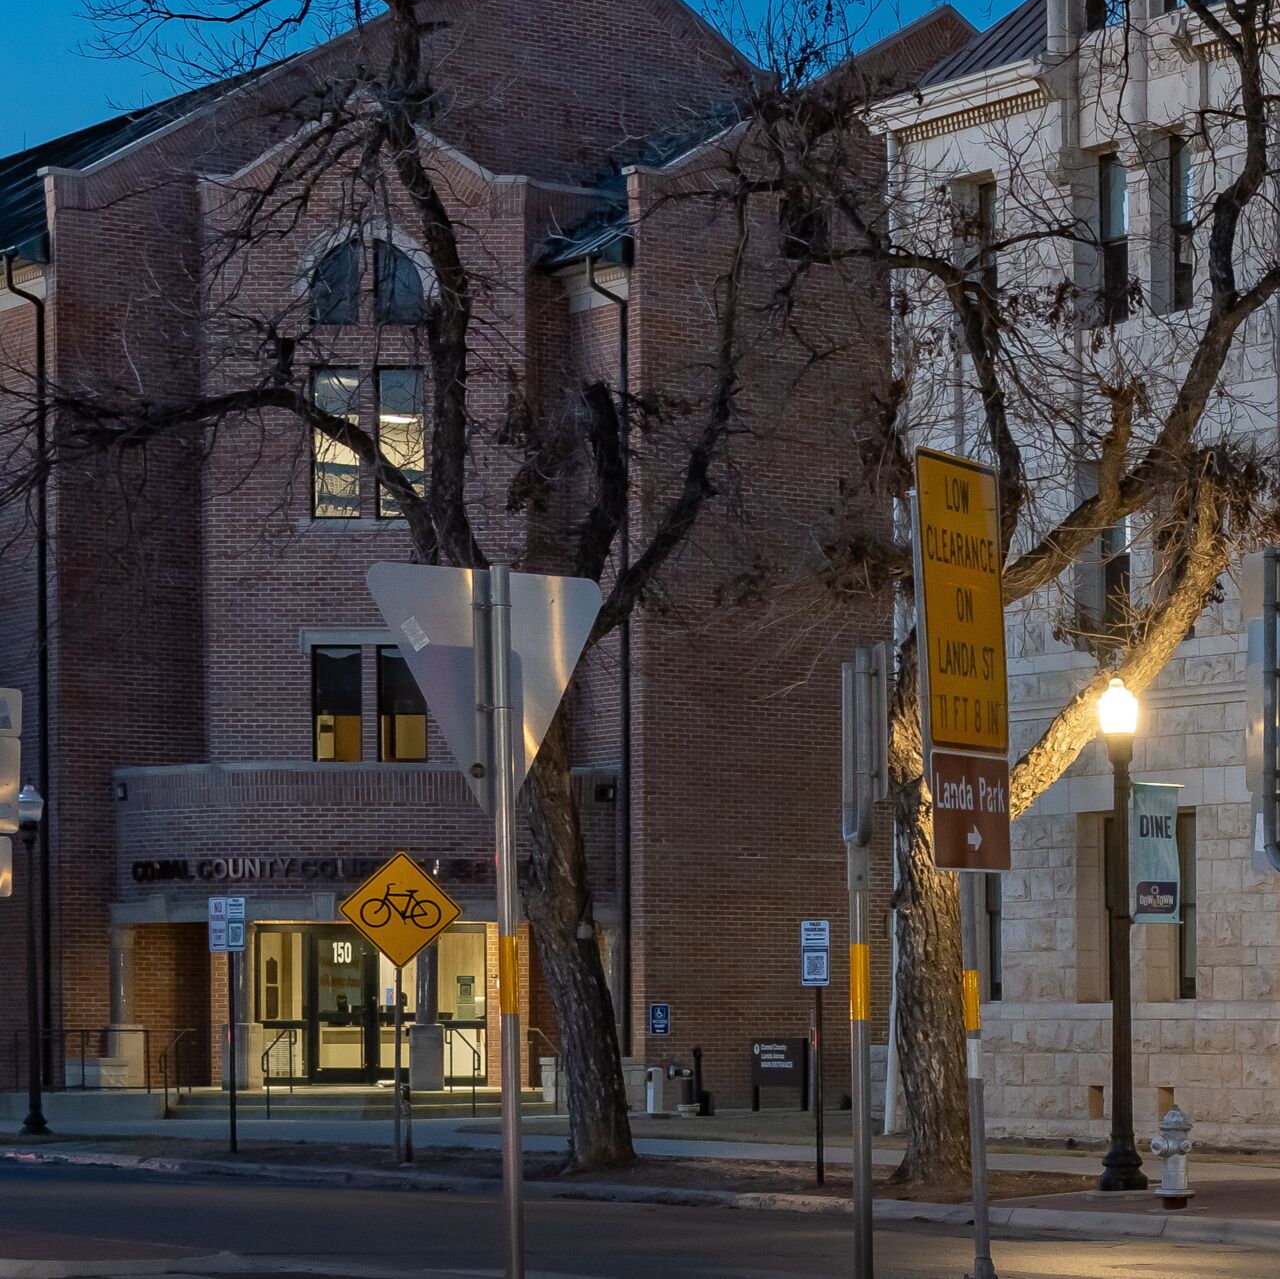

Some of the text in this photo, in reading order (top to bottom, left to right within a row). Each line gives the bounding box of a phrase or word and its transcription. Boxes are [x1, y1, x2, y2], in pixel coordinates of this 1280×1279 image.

[944, 474, 970, 515] LOW
[925, 524, 996, 574] CLEARANCE
[955, 586, 974, 625] ON
[937, 637, 995, 681] LANDA ST
[953, 695, 969, 732] FT
[974, 698, 982, 734] 8
[987, 700, 999, 736] IN
[936, 772, 1005, 813] Landa Park
[1139, 814, 1173, 839] DINE
[198, 857, 292, 880] COUNTY
[332, 941, 352, 964] 150
